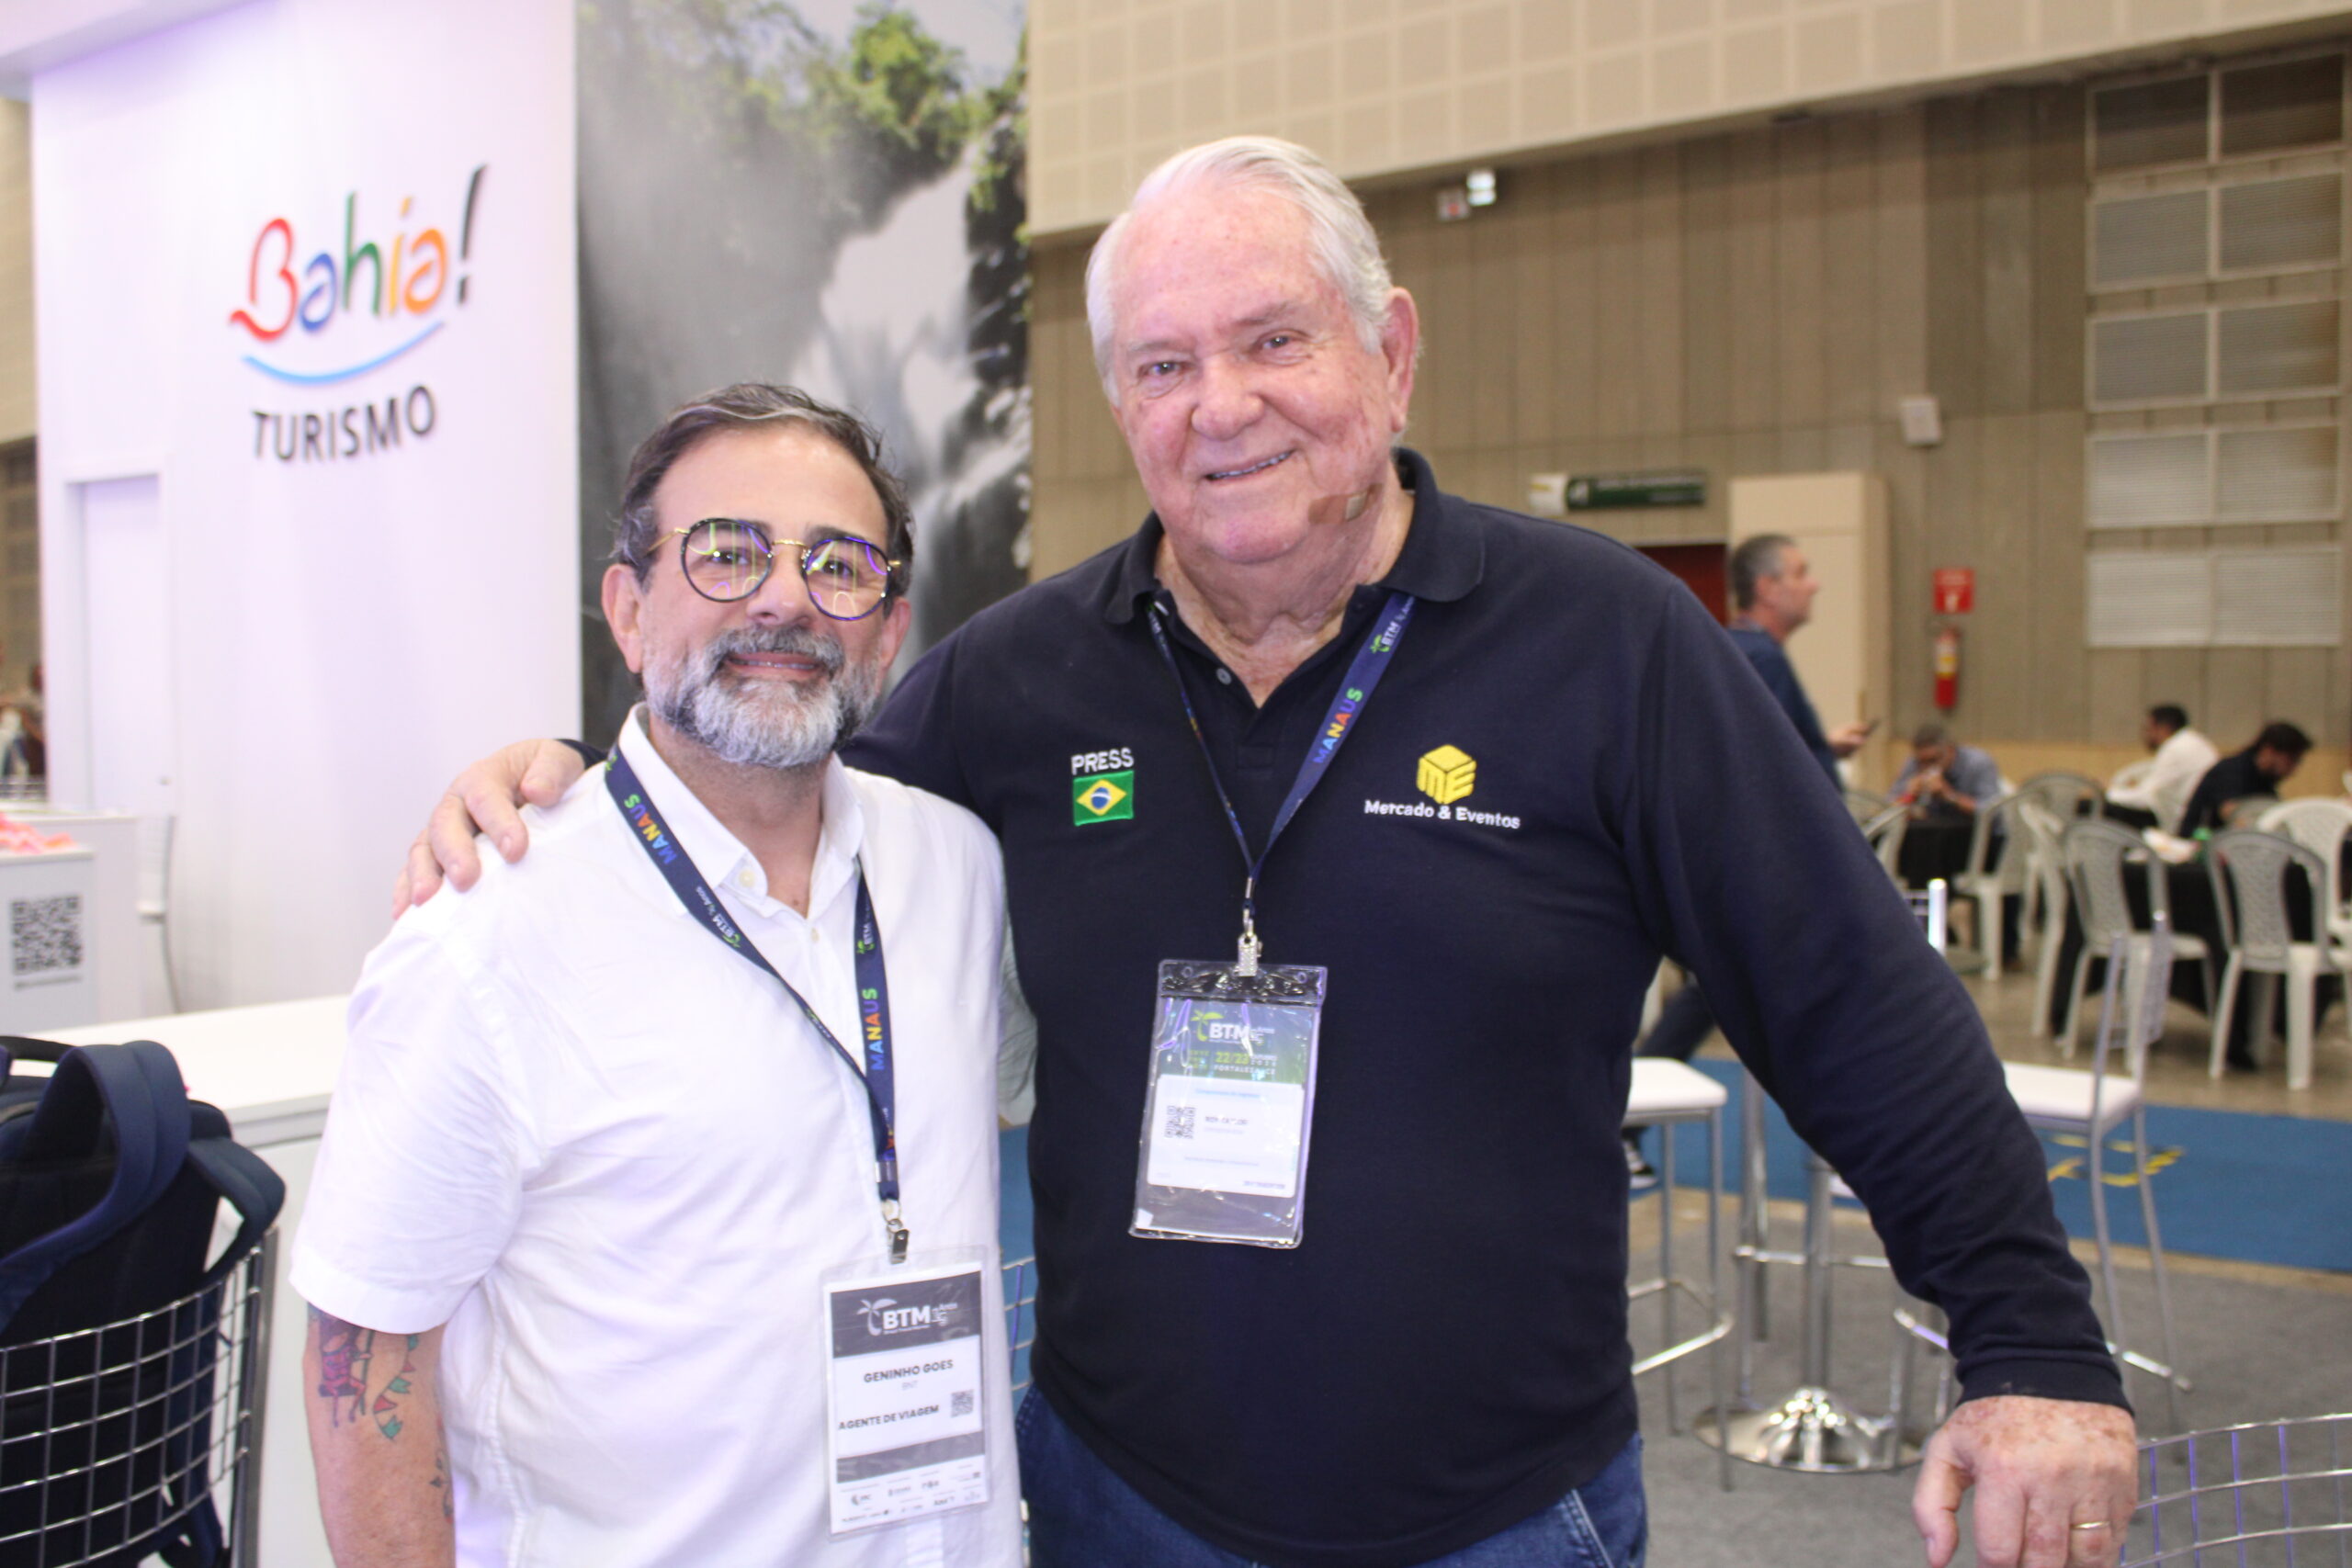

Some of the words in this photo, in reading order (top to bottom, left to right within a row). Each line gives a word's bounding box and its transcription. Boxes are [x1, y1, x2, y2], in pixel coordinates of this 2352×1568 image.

[252, 384, 436, 462] TURISMO
[1381, 621, 1402, 647] BTM
[1312, 687, 1363, 764] MANAUS
[1071, 747, 1135, 776] PRESS
[1364, 799, 1434, 818] Mercado
[1437, 805, 1452, 820] &
[1455, 806, 1521, 829] Eventos
[624, 794, 677, 864] MANAUS
[712, 912, 735, 938] BTM
[862, 987, 885, 1071] MANAUS
[1209, 1023, 1250, 1040] BTM
[883, 1305, 931, 1331] BTM
[864, 1365, 920, 1383] GENINHO
[922, 1359, 954, 1373] GOES
[838, 1416, 882, 1430] AGENTE
[883, 1413, 897, 1424] DE
[899, 1404, 940, 1420] VIAGEM
